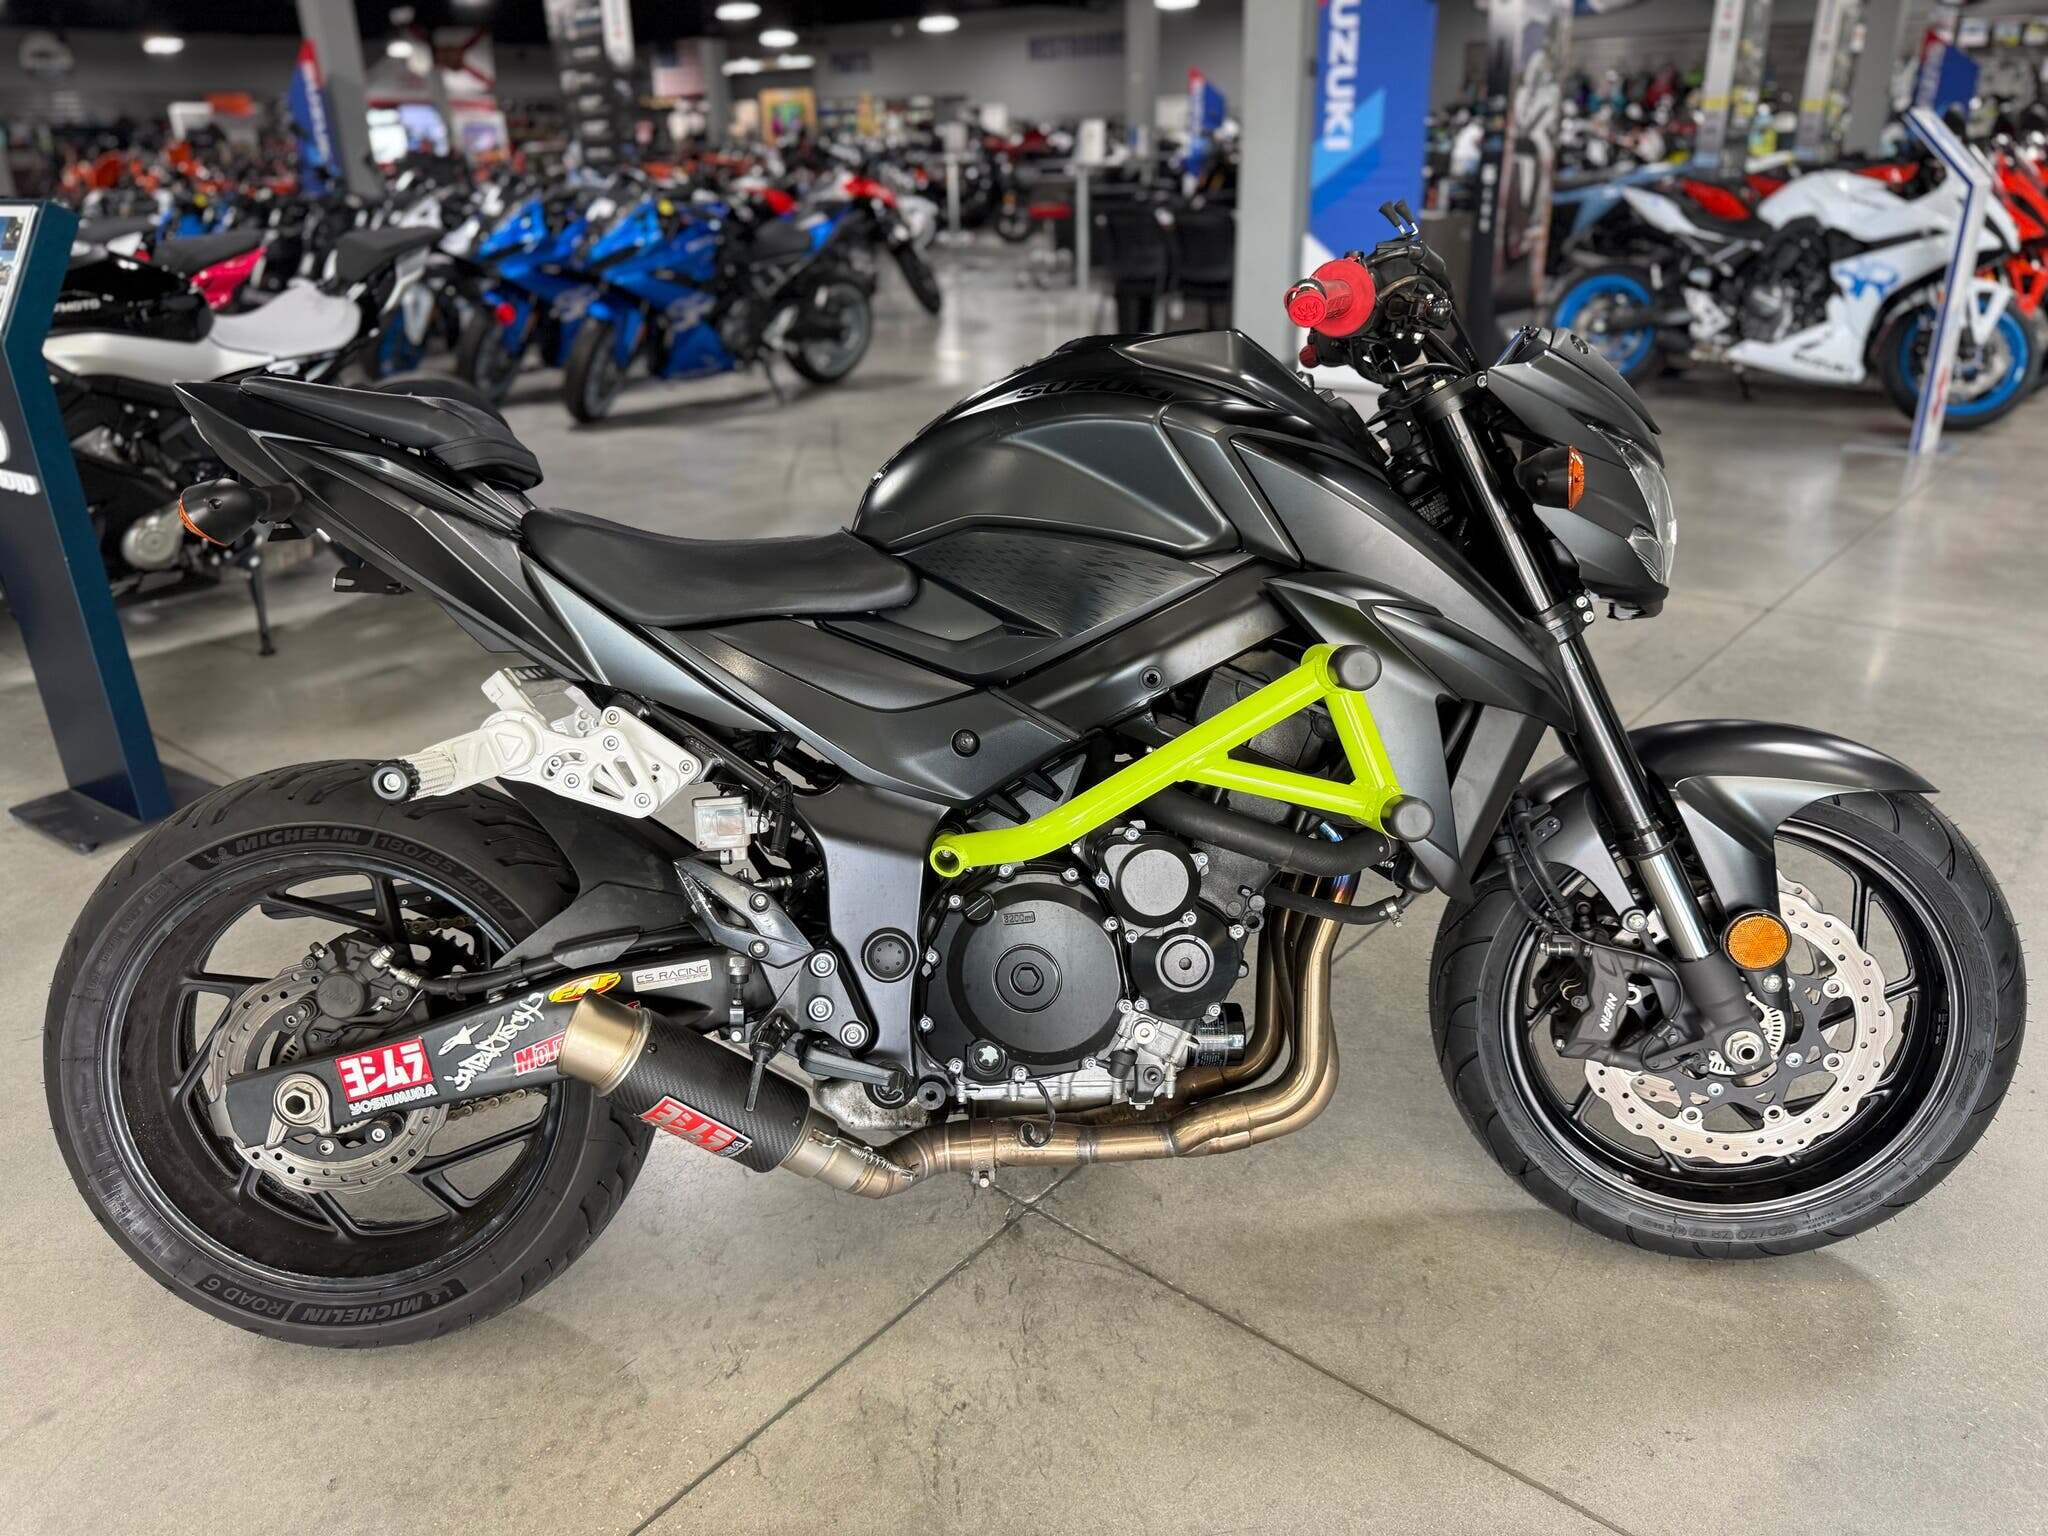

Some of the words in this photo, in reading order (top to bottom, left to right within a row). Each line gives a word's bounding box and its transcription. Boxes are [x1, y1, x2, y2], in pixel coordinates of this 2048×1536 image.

[1323, 0, 1362, 152] UZUKI
[1015, 379, 1175, 401] SUZUKI
[235, 827, 361, 853] MICHELIN
[636, 973, 655, 985] CS
[658, 964, 709, 980] RACING
[340, 1041, 422, 1098] ヨシムラ
[348, 1084, 438, 1116] YOSHIMURA
[202, 1277, 222, 1292] 6
[222, 1283, 287, 1317] ROAD
[300, 1296, 423, 1323] MICHELIN
